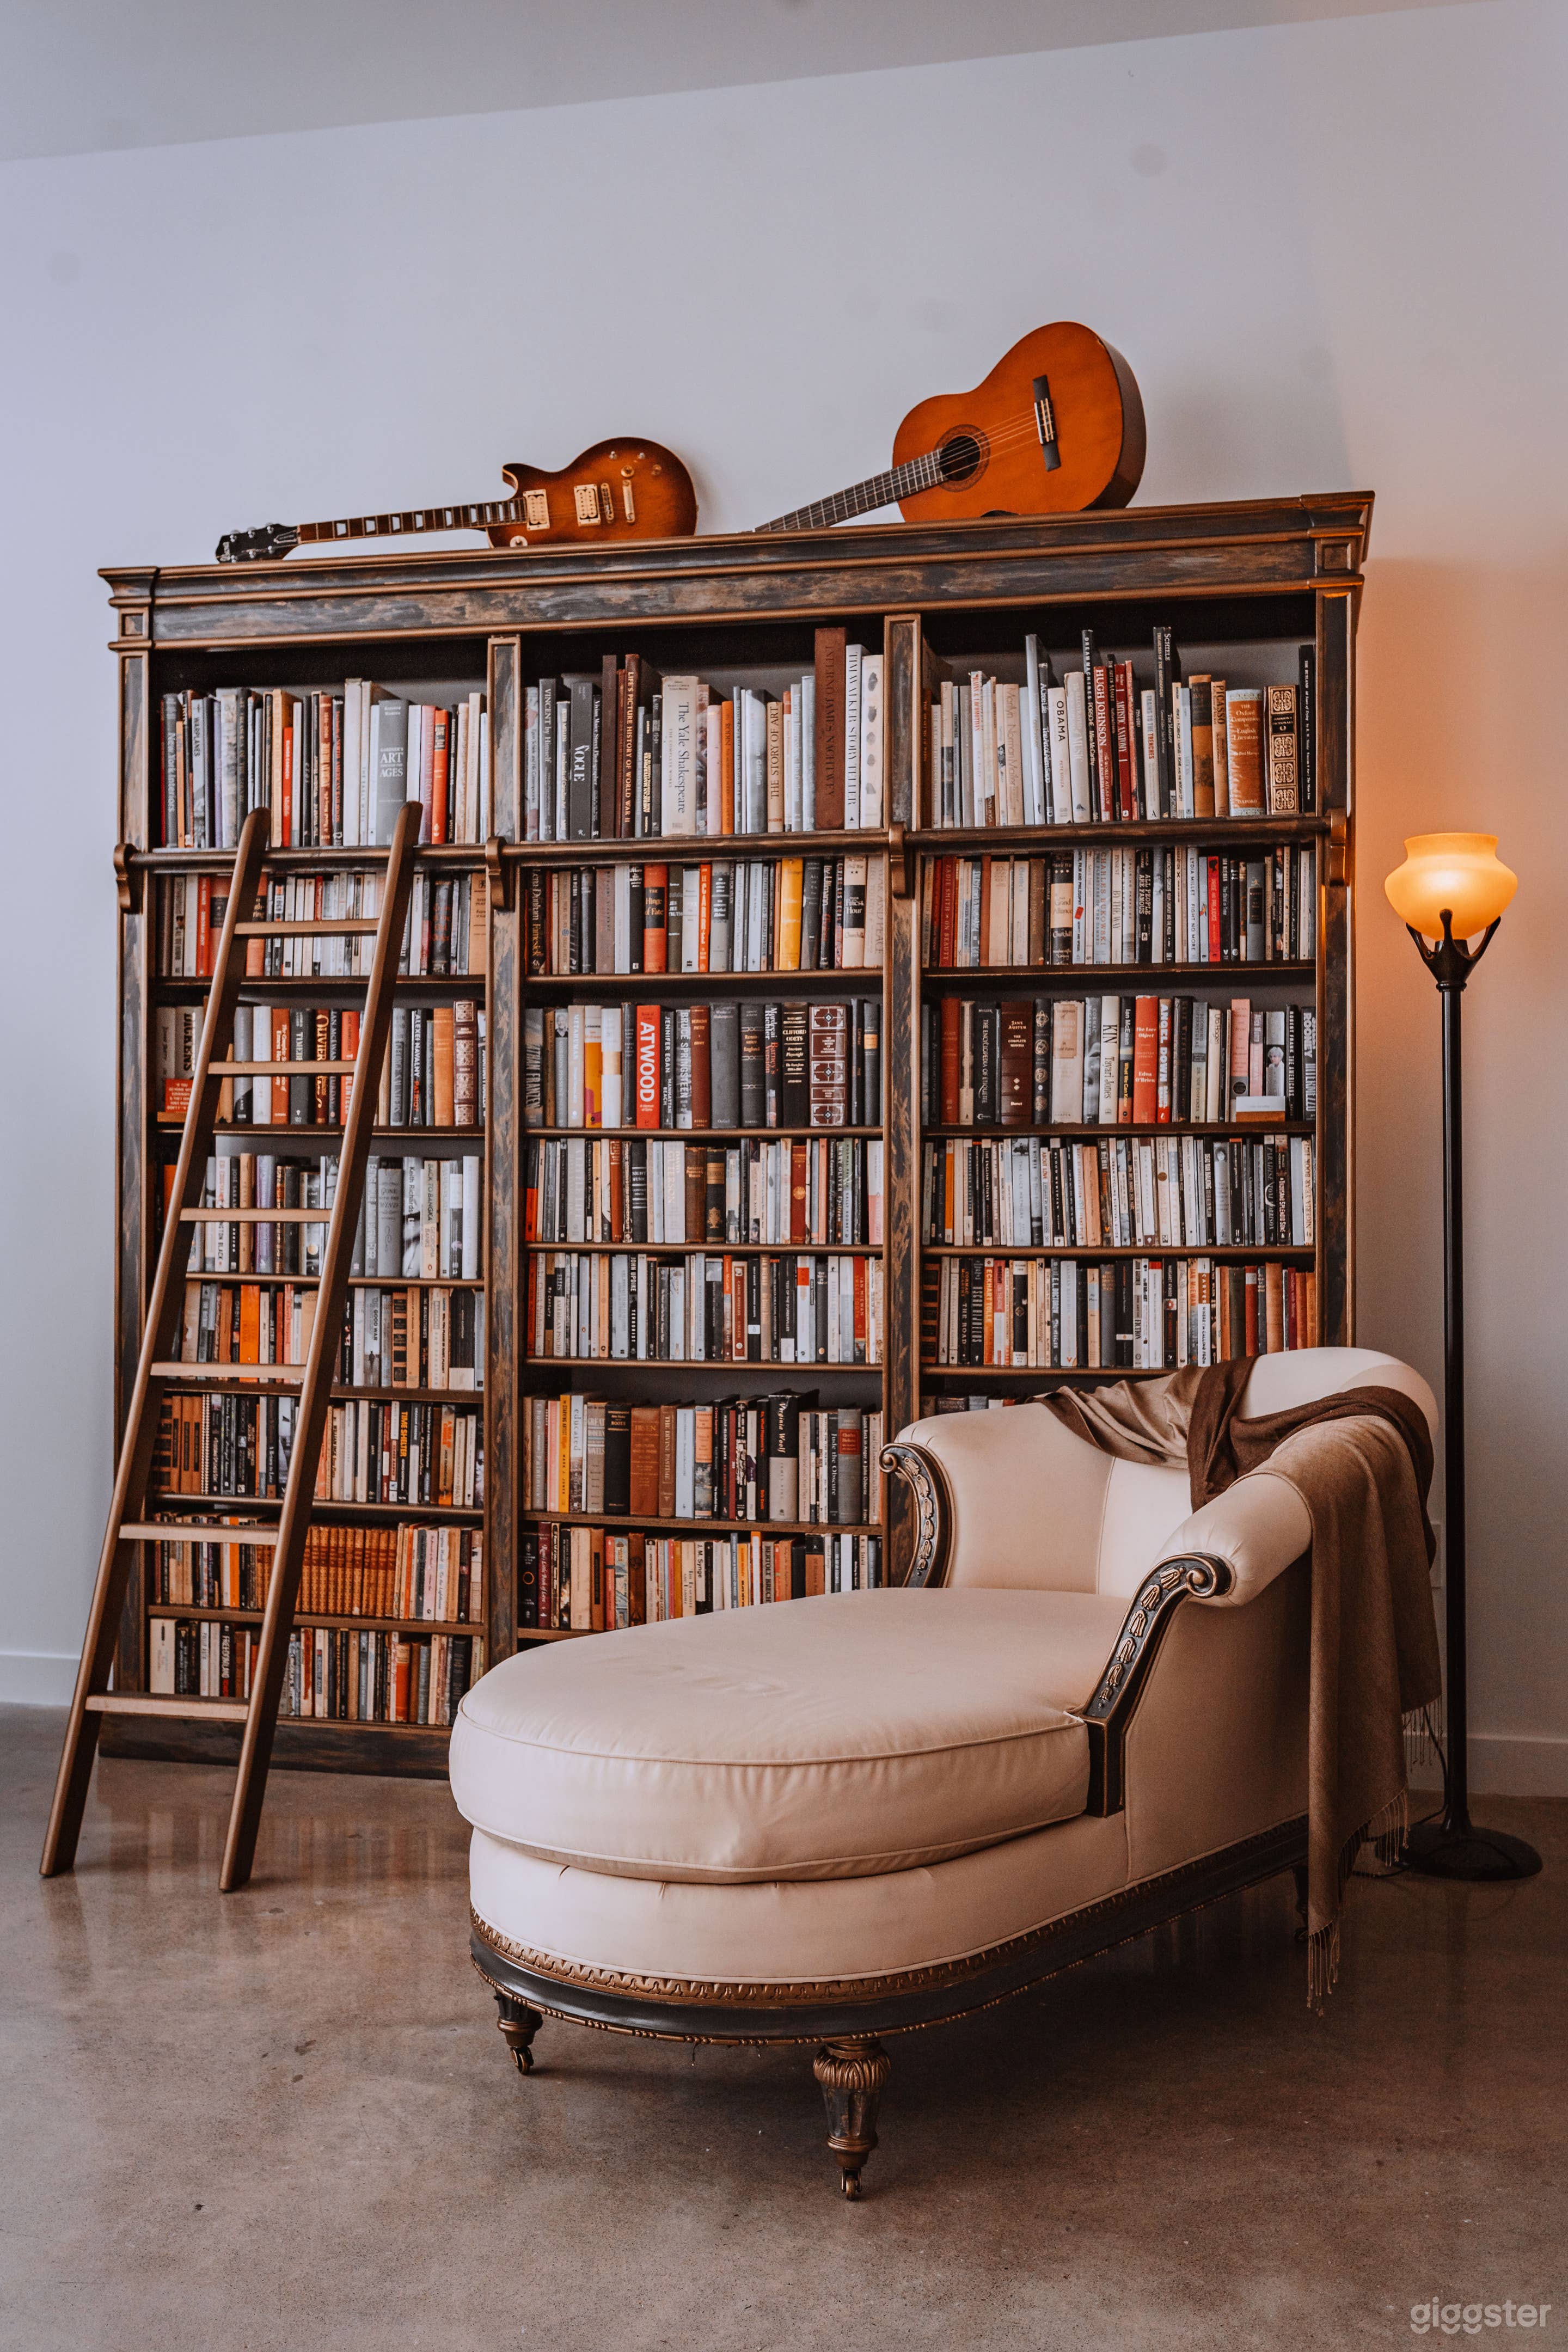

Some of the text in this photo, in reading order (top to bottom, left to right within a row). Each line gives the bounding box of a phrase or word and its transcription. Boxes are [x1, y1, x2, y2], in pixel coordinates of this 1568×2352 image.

[825, 646, 834, 797] INFERNO JAMES NACHTWEY
[847, 653, 857, 805] TIM WALKER STORY TELLER
[1007, 688, 1019, 785] Marilyn Norman Mailer
[1057, 701, 1065, 742] OBAMA
[1096, 670, 1106, 745] HUGH JOHNSON
[380, 768, 403, 777] AGES
[381, 752, 403, 763] ART
[574, 745, 590, 781] VOGUE
[626, 759, 631, 769] OF
[675, 702, 689, 813] The Yale Shakespeare
[770, 706, 779, 799] THE STORY OF ART
[1191, 923, 1196, 932] NO
[317, 1014, 328, 1061] OLIVIER
[641, 1021, 655, 1101] ATWOOD
[680, 1012, 688, 1098] BRUCE SPRINGSTEEN
[1103, 1025, 1117, 1098] KIN Tayari Jones
[1303, 1013, 1312, 1057] ROONEY
[777, 1403, 786, 1453] Virginia Woolf
